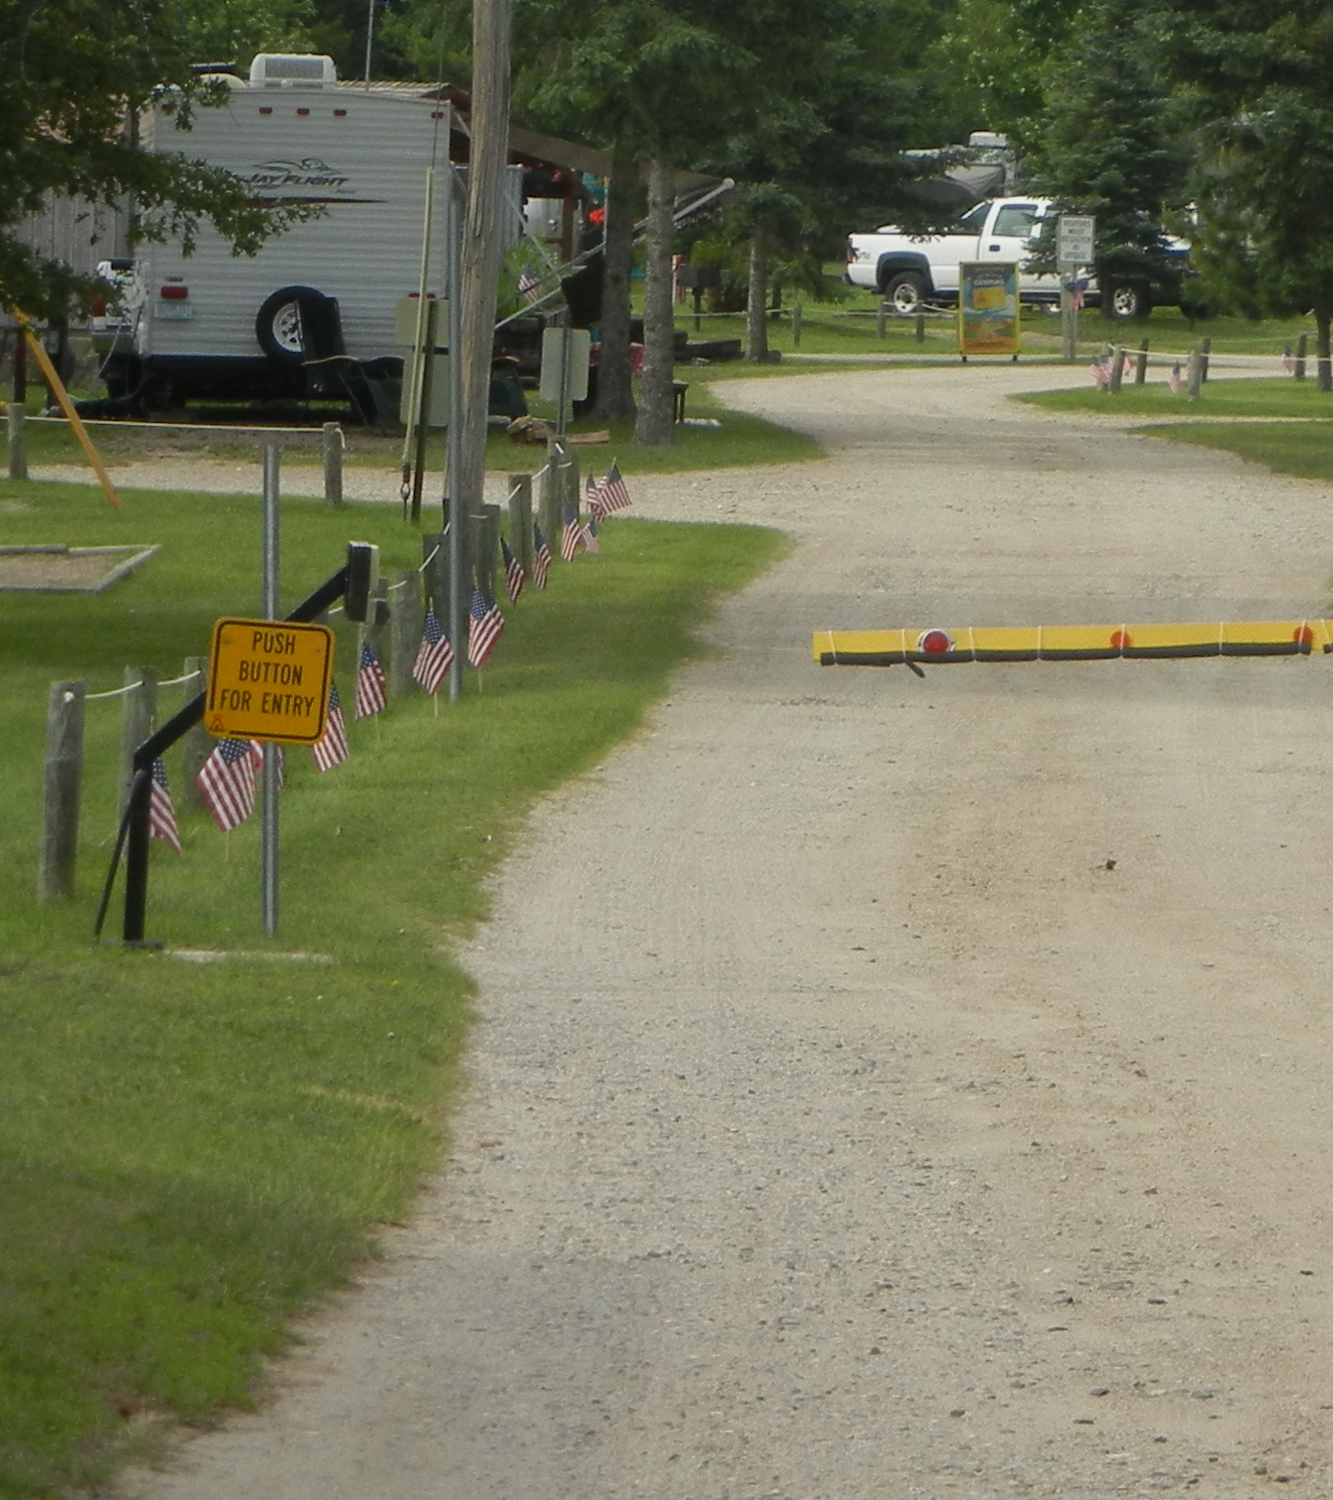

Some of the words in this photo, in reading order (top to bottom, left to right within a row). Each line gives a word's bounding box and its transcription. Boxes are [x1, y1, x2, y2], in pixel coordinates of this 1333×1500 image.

[252, 631, 296, 655] PUSH
[239, 660, 303, 686] BUTTON
[220, 689, 252, 712] FOR
[261, 692, 315, 718] ENTRY
